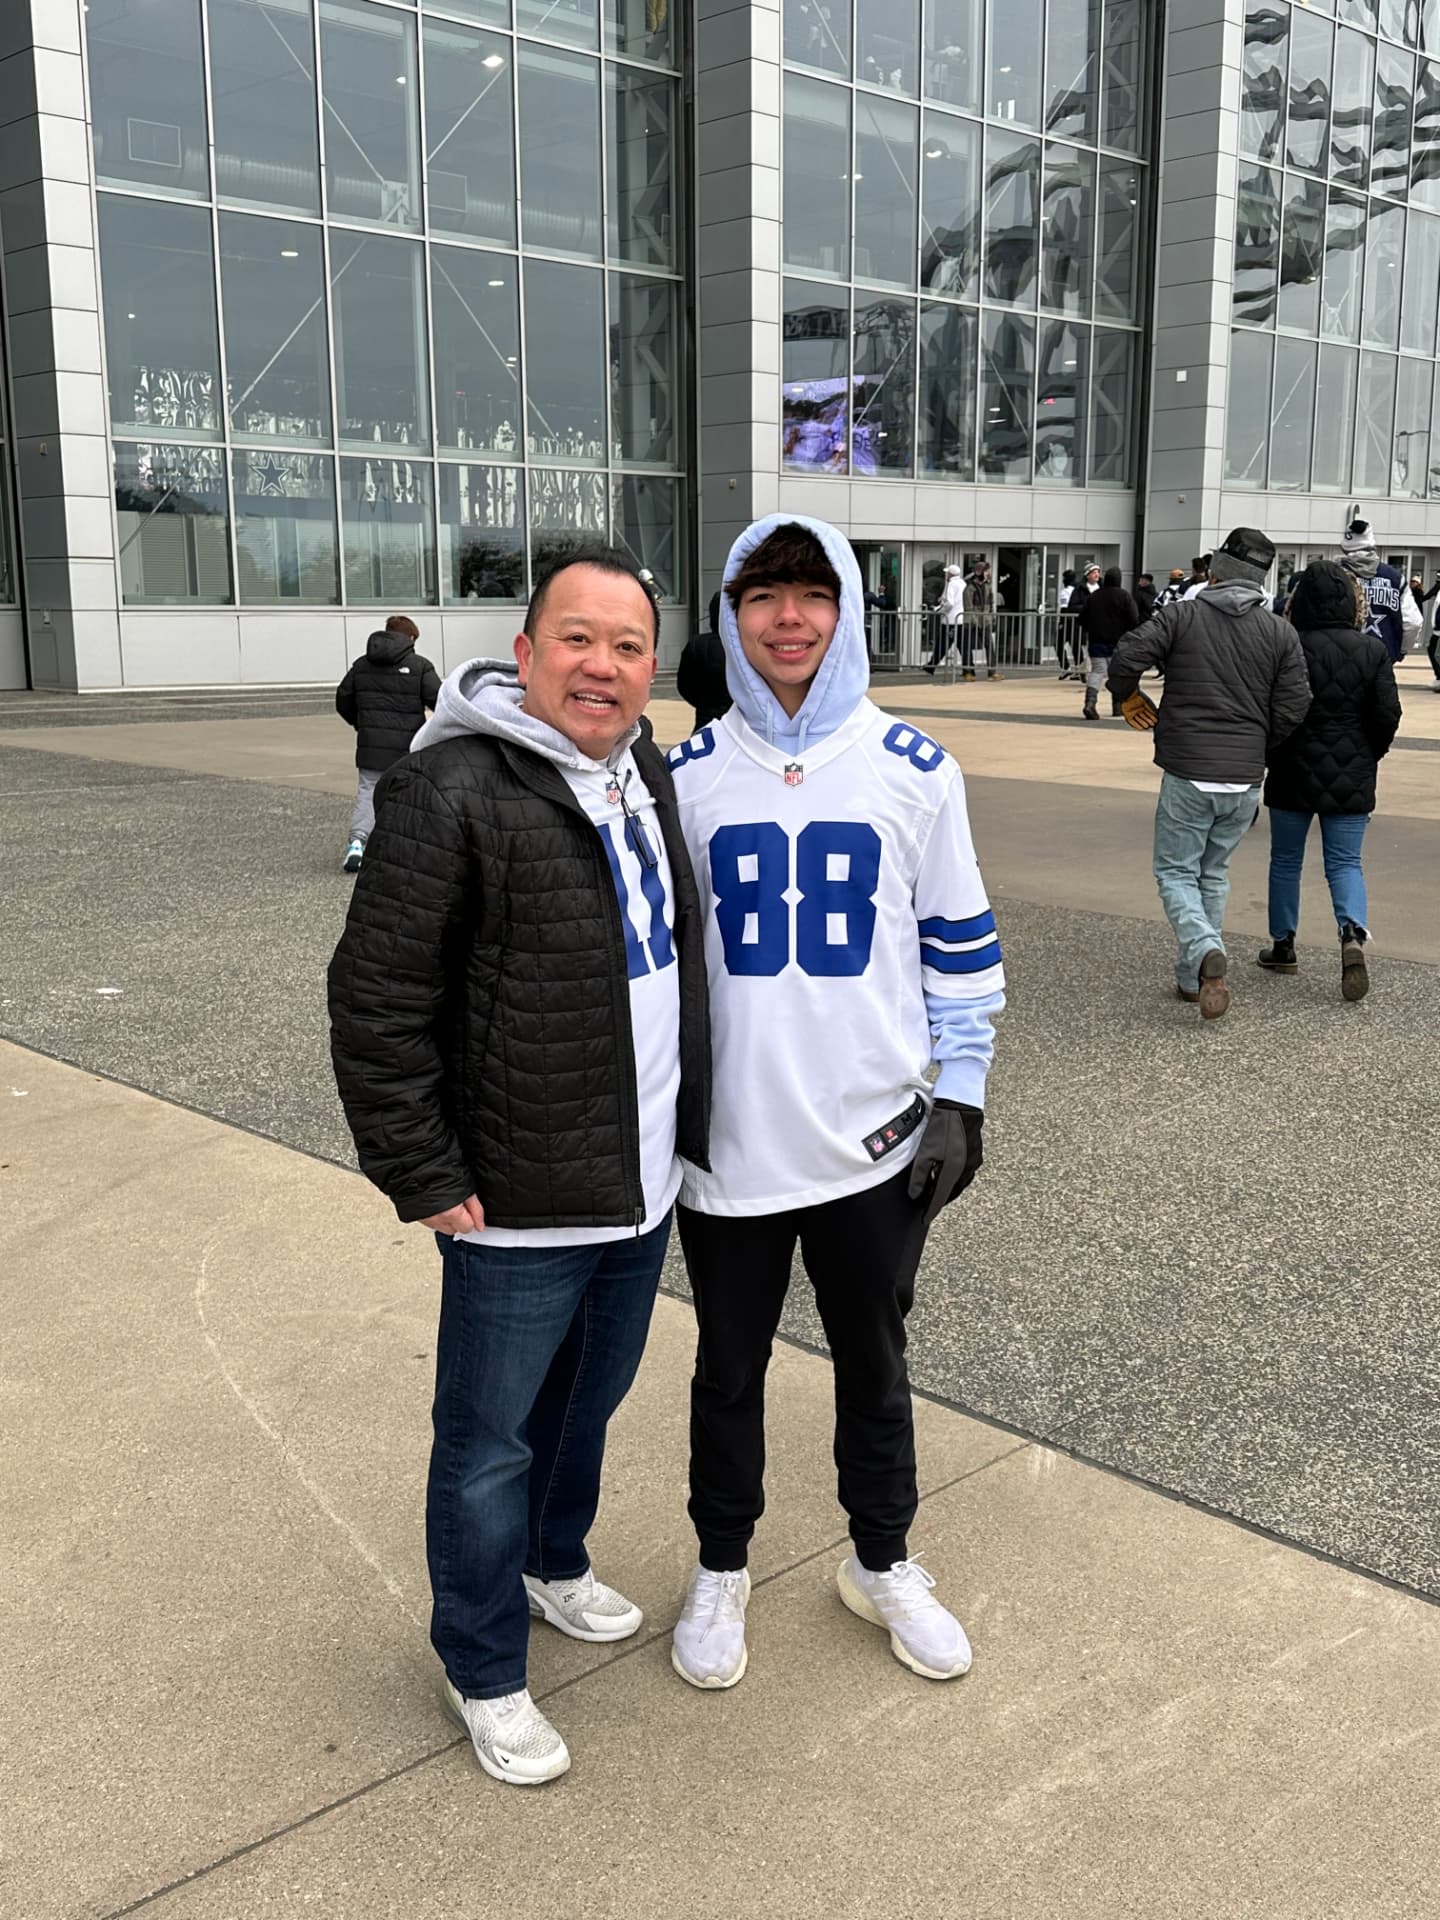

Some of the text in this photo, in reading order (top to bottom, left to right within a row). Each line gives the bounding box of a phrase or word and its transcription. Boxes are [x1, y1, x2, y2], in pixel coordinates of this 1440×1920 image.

[1365, 586, 1400, 612] PIONS
[882, 722, 945, 773] 8
[709, 820, 882, 977] 88
